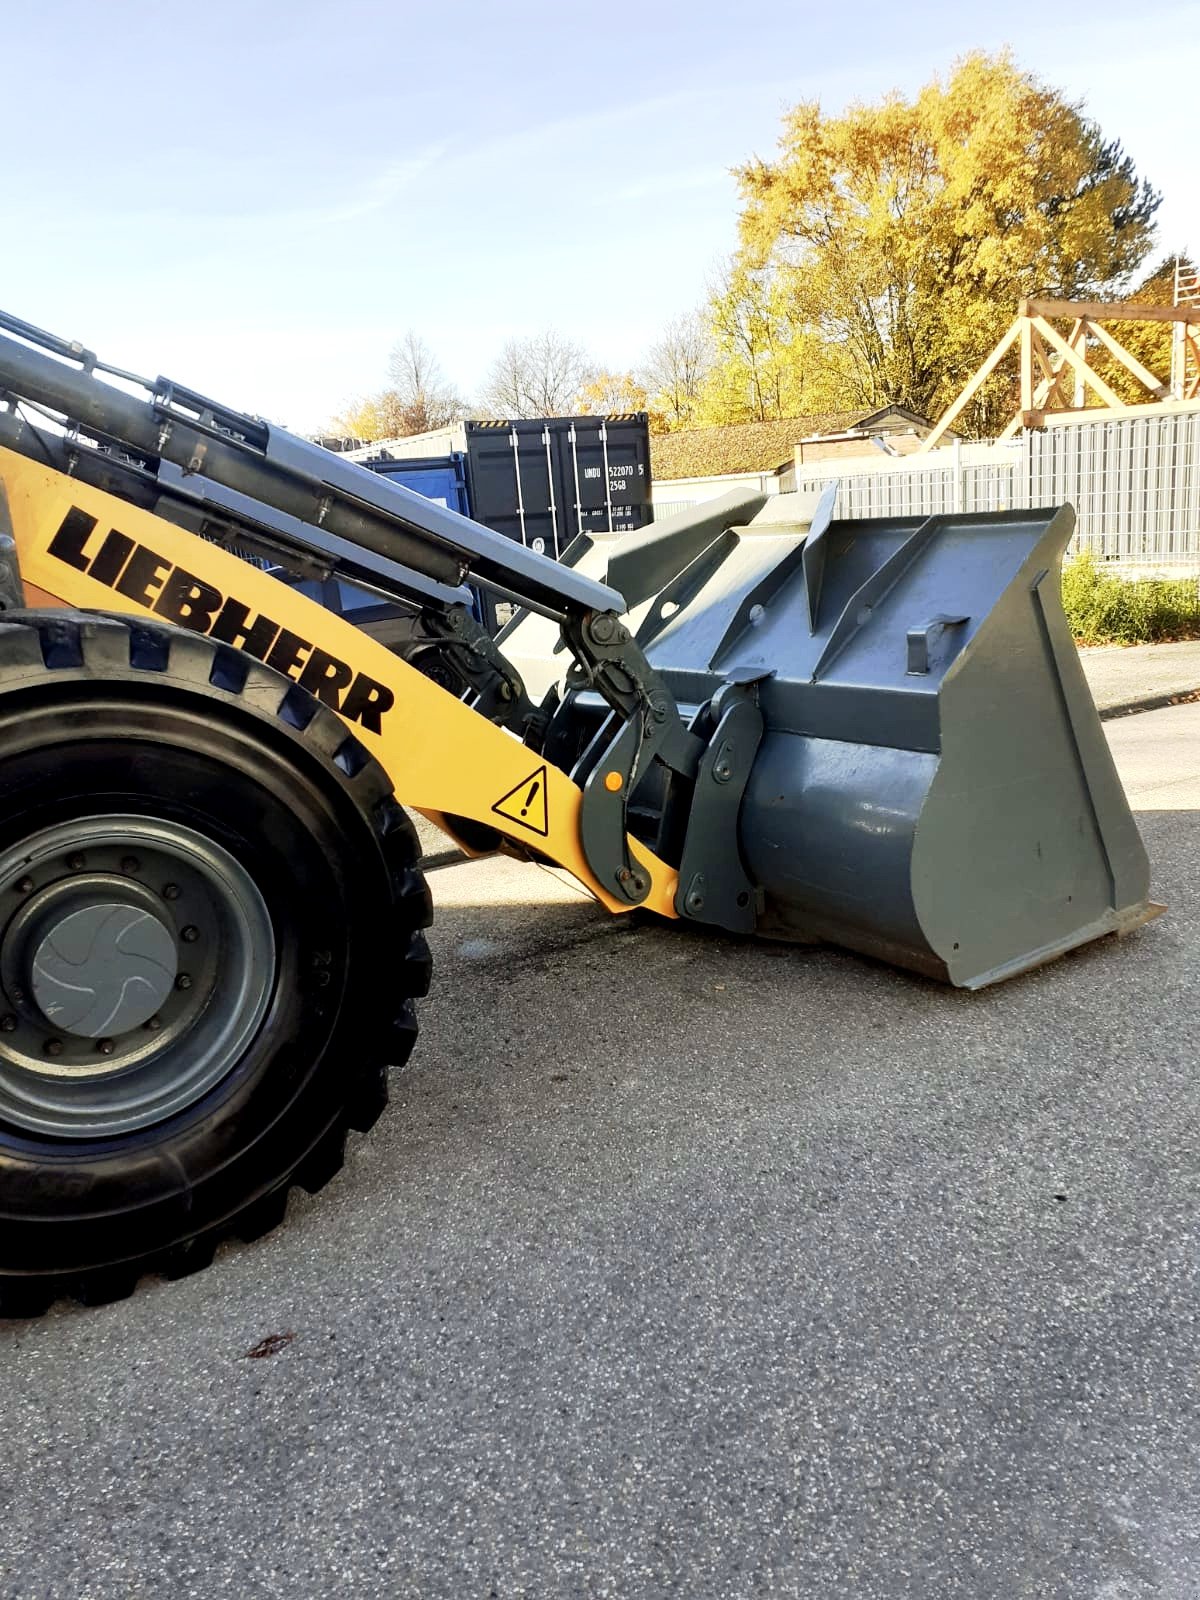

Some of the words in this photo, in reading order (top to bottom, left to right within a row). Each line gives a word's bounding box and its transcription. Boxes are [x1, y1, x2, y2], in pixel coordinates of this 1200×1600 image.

[608, 465, 633, 477] 522070
[637, 463, 644, 475] 5
[47, 505, 394, 736] LIEBHERR
